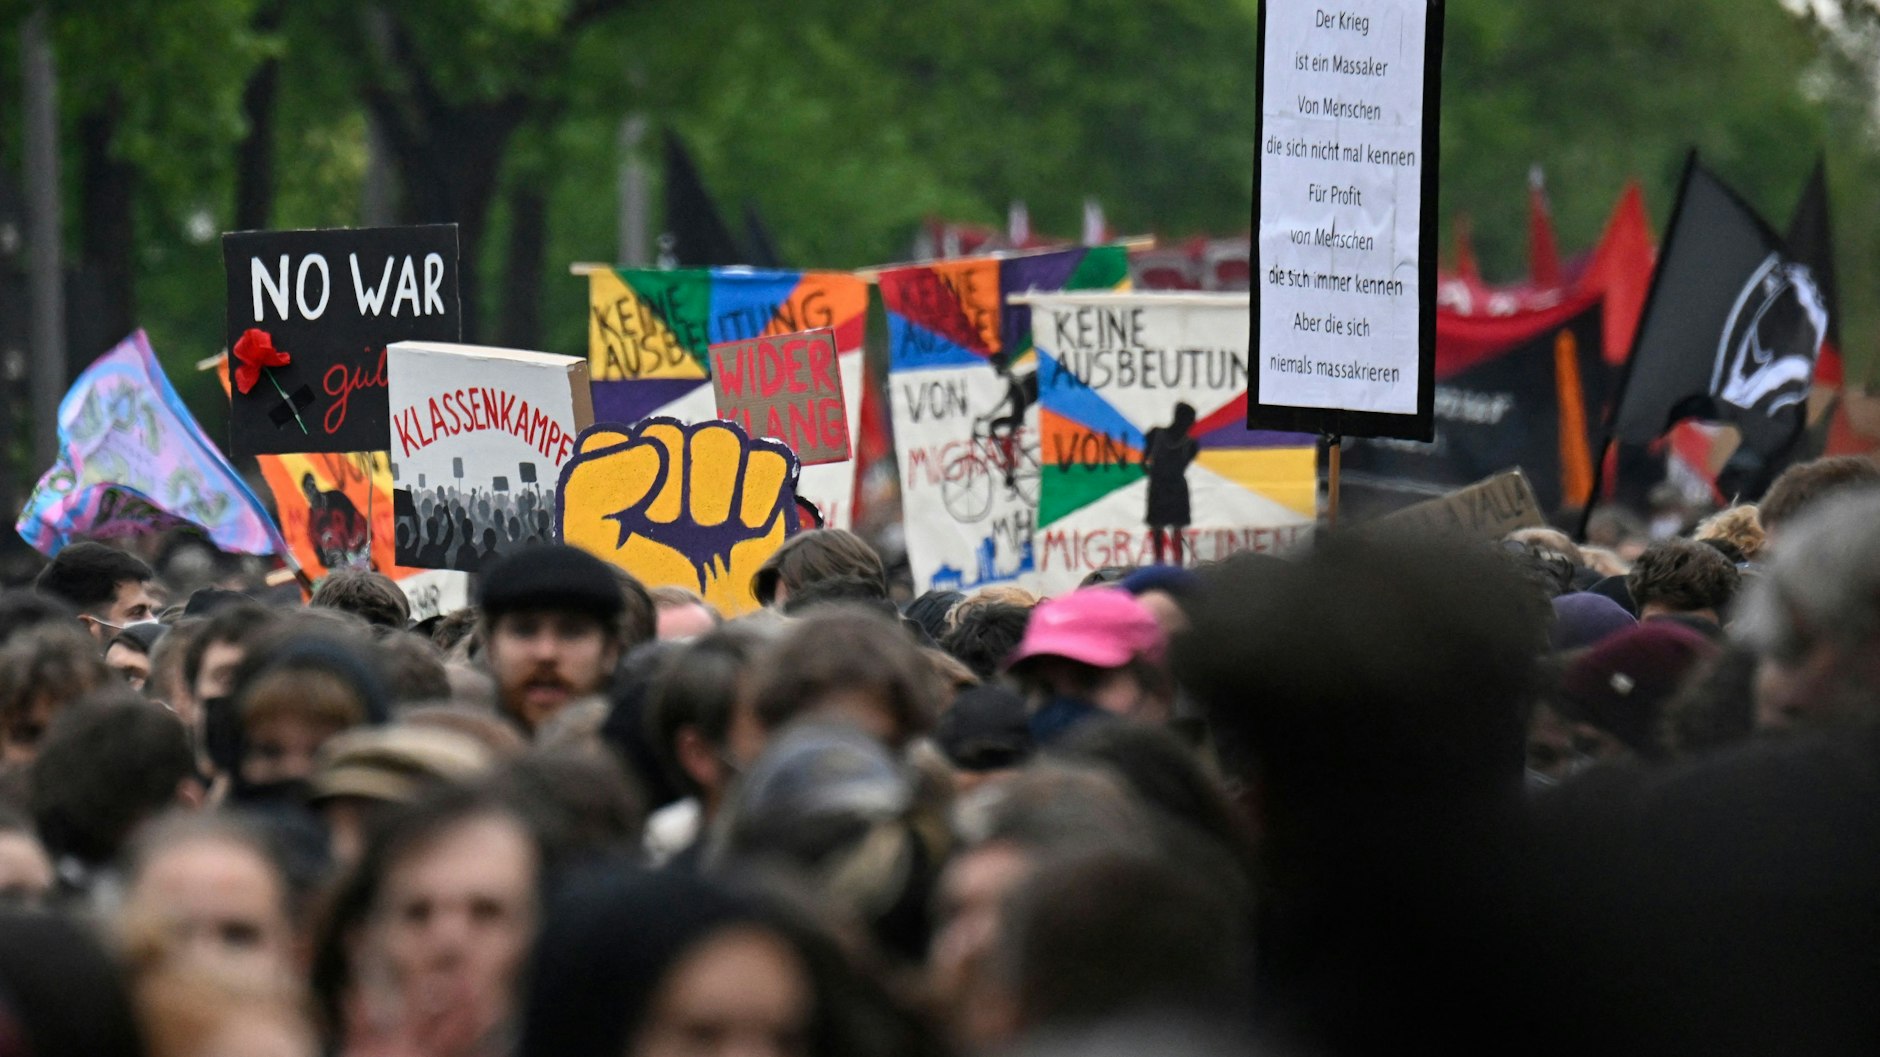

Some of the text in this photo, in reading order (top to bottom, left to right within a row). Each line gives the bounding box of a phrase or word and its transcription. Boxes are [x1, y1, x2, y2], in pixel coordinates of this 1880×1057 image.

[1315, 9, 1370, 36] Der Krieg
[1295, 52, 1388, 76] ist ein Massaker
[1298, 95, 1381, 120] Von Menschen
[1266, 134, 1416, 167] die sich nicht mal kennen
[1309, 183, 1362, 207] Für Profit
[1290, 227, 1374, 251] von Menschen
[250, 252, 446, 322] NO WAR
[1269, 264, 1403, 296] die sich immer kennen
[1054, 304, 1147, 350] KEINE
[1294, 312, 1370, 337] Aber die sich
[715, 338, 837, 399] WIDER
[1270, 353, 1400, 383] niemals massakrieren
[904, 379, 968, 424] VON
[393, 387, 575, 467] KLASSENKAMPF
[717, 397, 845, 452] LANG
[1053, 431, 1130, 474] VON
